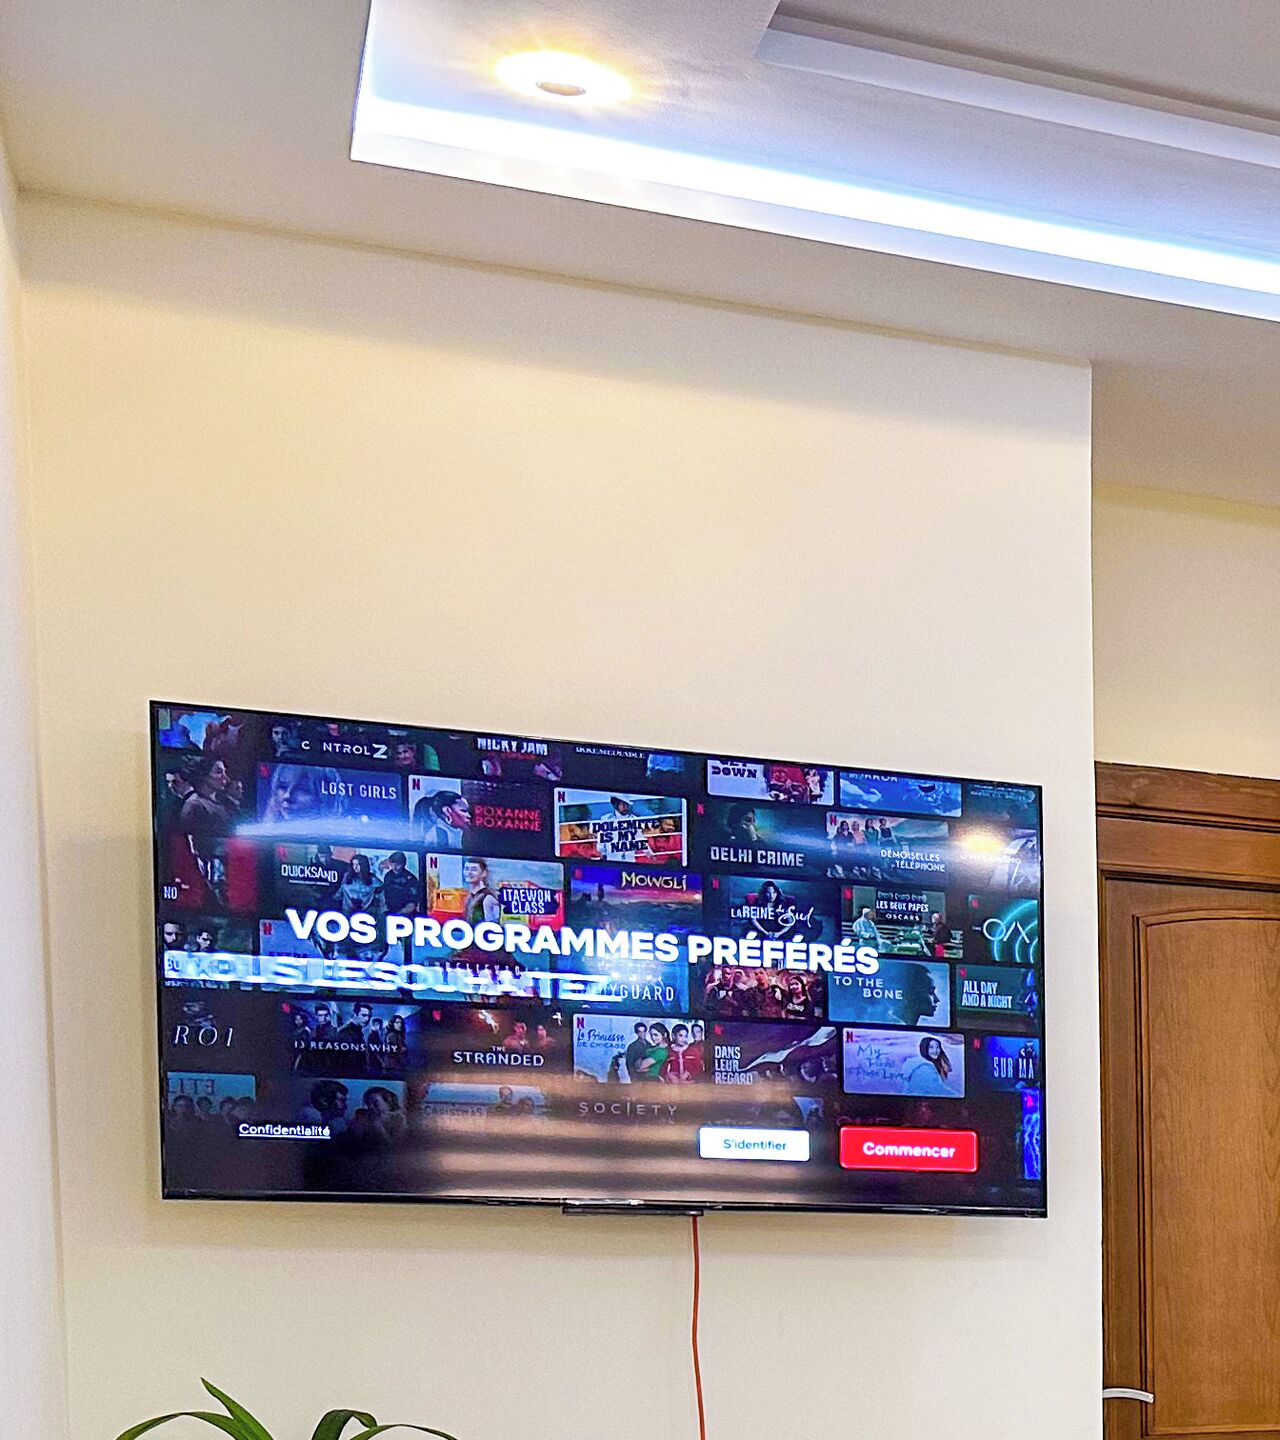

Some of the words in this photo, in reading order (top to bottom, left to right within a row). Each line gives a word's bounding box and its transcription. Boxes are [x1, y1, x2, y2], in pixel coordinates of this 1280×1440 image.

[301, 739, 371, 756] CNTROL
[521, 742, 548, 756] JAM
[711, 764, 758, 779] DOWN
[321, 780, 353, 798] LOST
[359, 784, 398, 800] GIRLS
[474, 805, 542, 820] ROXANNE
[475, 816, 542, 832] ROXANNE
[600, 833, 614, 843] IS
[617, 830, 637, 842] MY
[611, 839, 649, 853] NAME
[710, 846, 752, 863] DELHI
[757, 850, 805, 868] CRIME
[281, 864, 338, 883] QUICKSAND
[503, 888, 551, 902] ITAEWON
[511, 901, 545, 914] CLASS
[876, 900, 888, 910] LES
[286, 908, 377, 944] VOS
[386, 914, 680, 963] PROGRAMMES
[688, 931, 880, 975] PRÉFÉRÉS
[833, 975, 852, 987] TO
[856, 977, 884, 988] THE
[963, 980, 979, 994] ALL
[981, 982, 998, 995] DAY
[863, 988, 903, 1000] BONE
[987, 995, 1013, 1009] NIGHT
[174, 1024, 234, 1048] ROI
[294, 1040, 306, 1049] 13
[310, 1040, 366, 1051] REASONS
[369, 1042, 398, 1053] WHY
[715, 1045, 741, 1060] DANS
[453, 1051, 544, 1067] STRANDED
[715, 1059, 740, 1072] LEUR
[993, 1056, 1013, 1079] SUR
[714, 1071, 754, 1086] REGARD
[577, 1101, 677, 1117] SOCIETY
[238, 1123, 331, 1138] Confidentialité
[723, 1138, 787, 1151] S'identifier
[862, 1141, 956, 1159] Commencer
